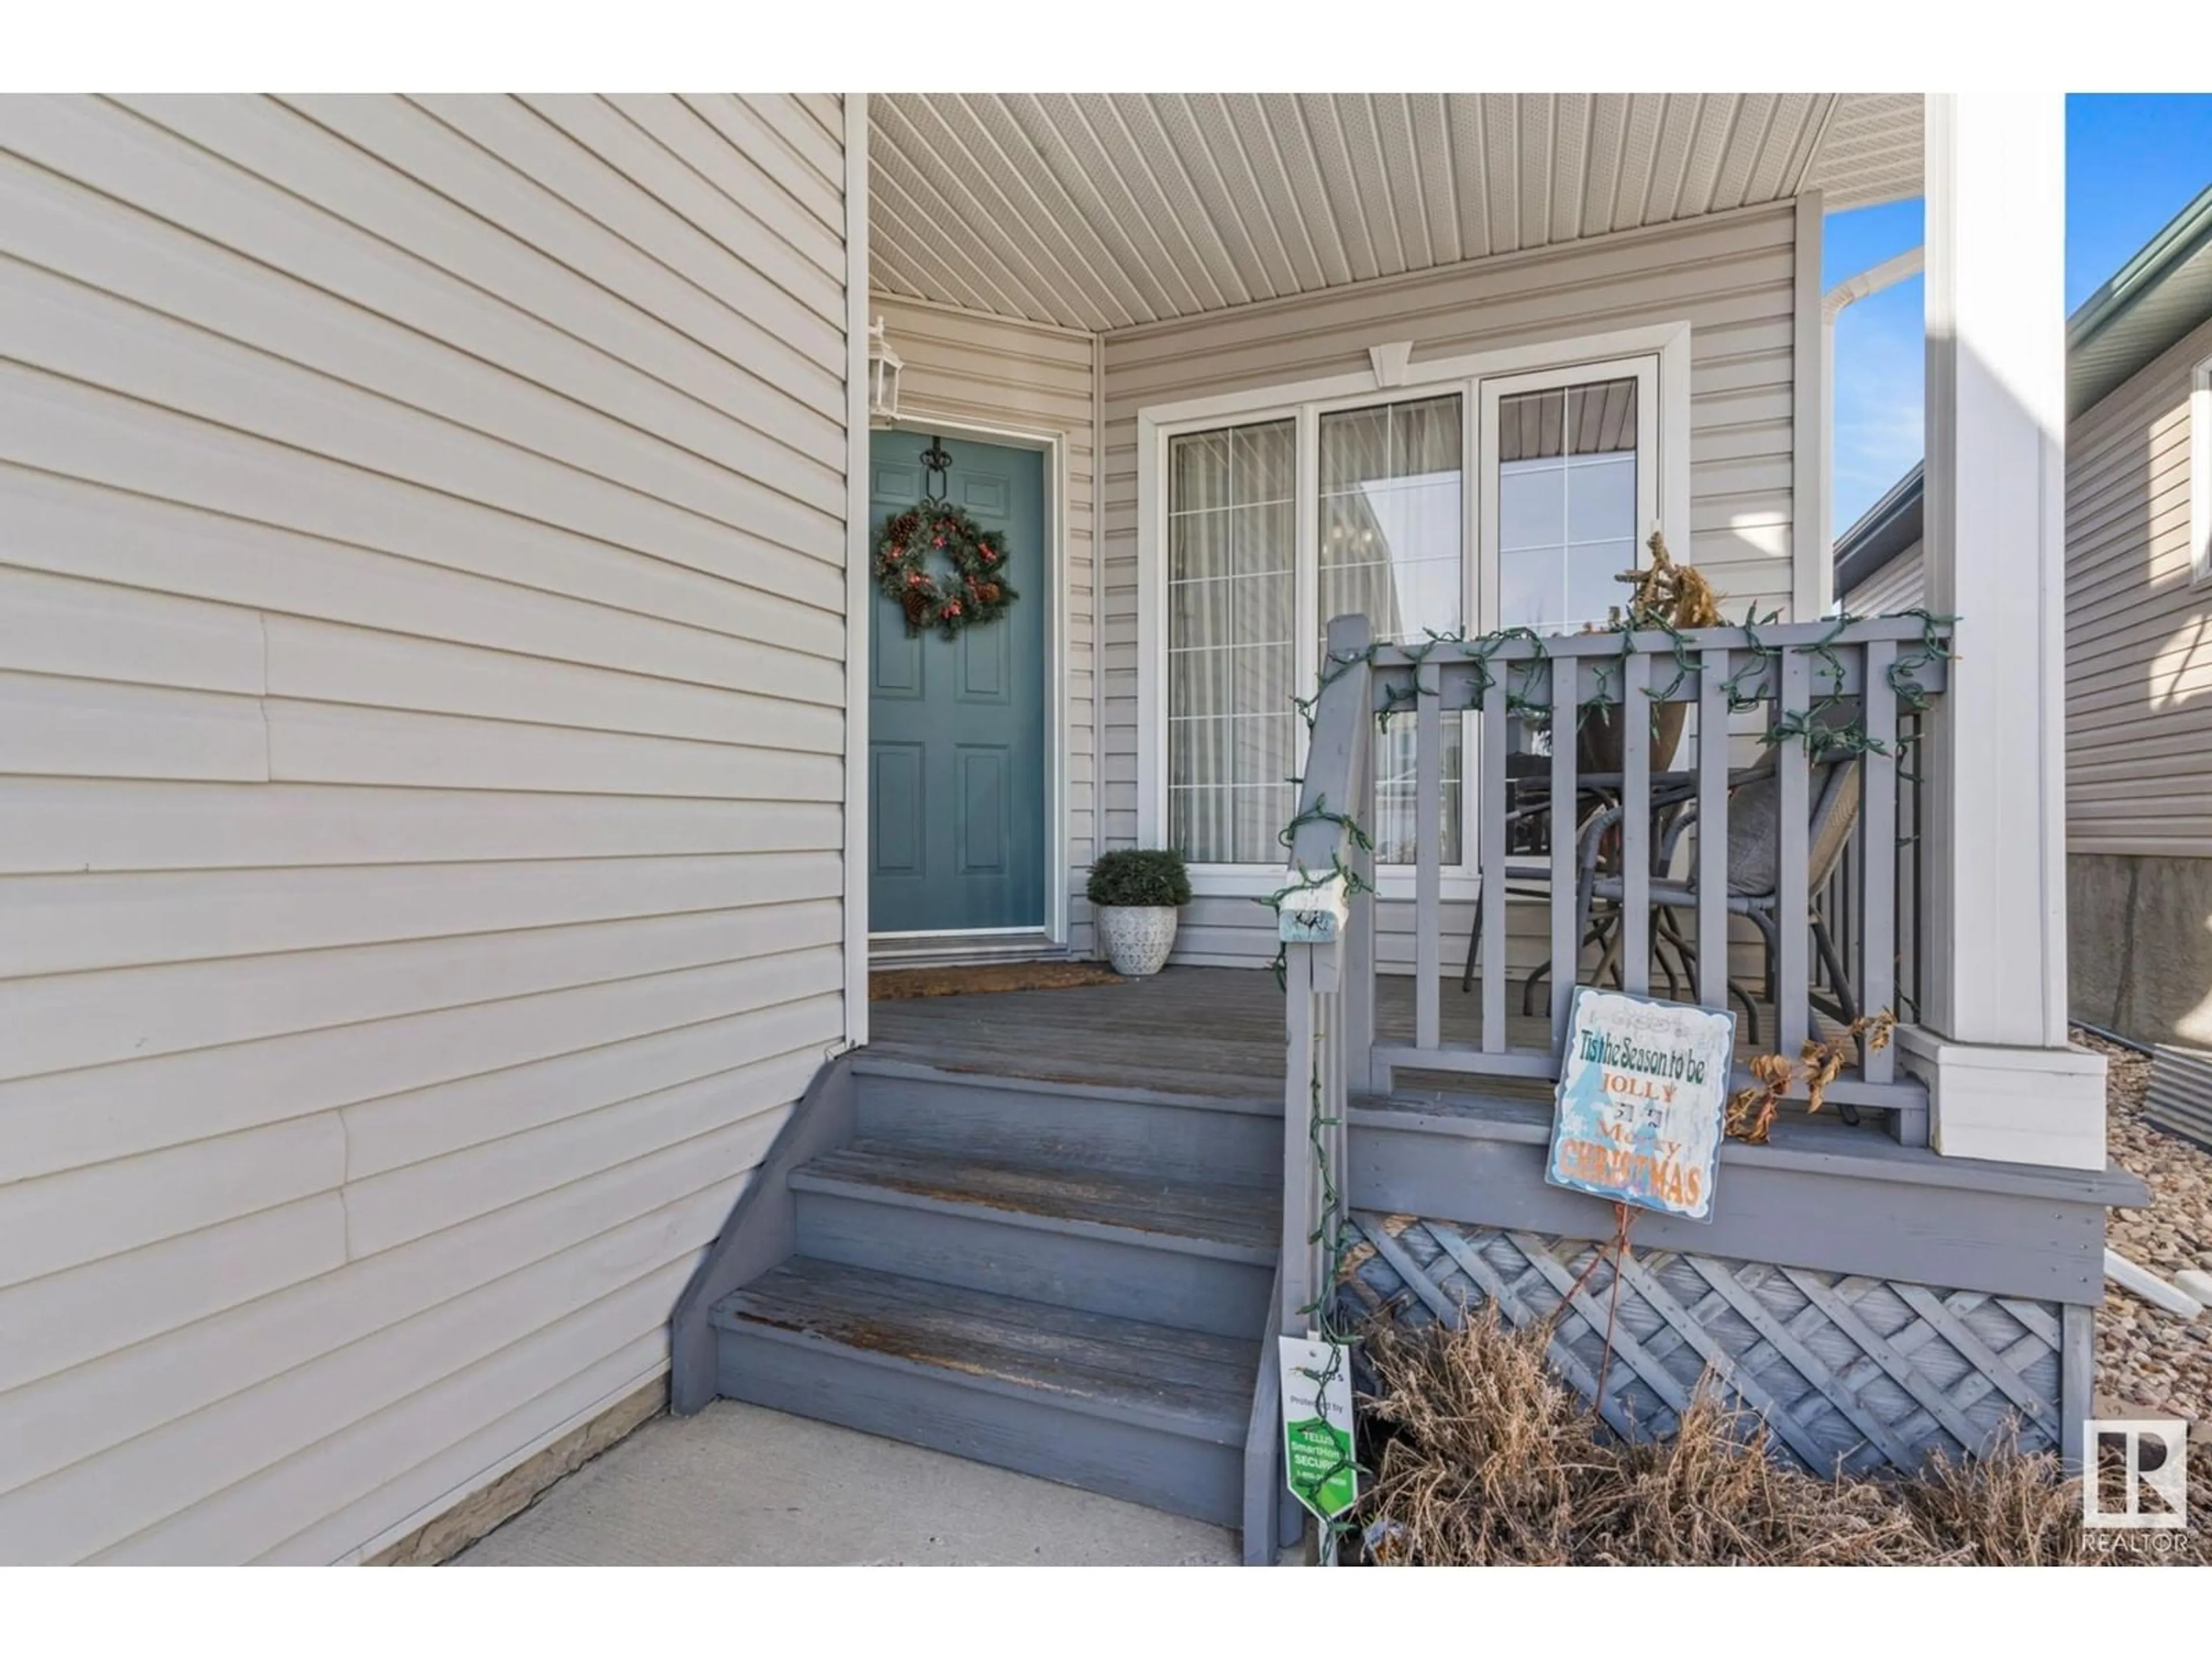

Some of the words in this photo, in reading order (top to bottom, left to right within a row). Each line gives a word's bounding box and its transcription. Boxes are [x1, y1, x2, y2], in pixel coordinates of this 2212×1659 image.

[1597, 1033, 1620, 1066] the
[1620, 1037, 1668, 1077] Season
[1668, 1050, 1684, 1080] to
[1686, 1048, 1705, 1084] be
[1599, 1073, 1677, 1103] JOLLY
[1290, 1395, 1331, 1411] Protecd
[1302, 1431, 1335, 1446] TELUS
[1291, 1441, 1349, 1459] SmartHom
